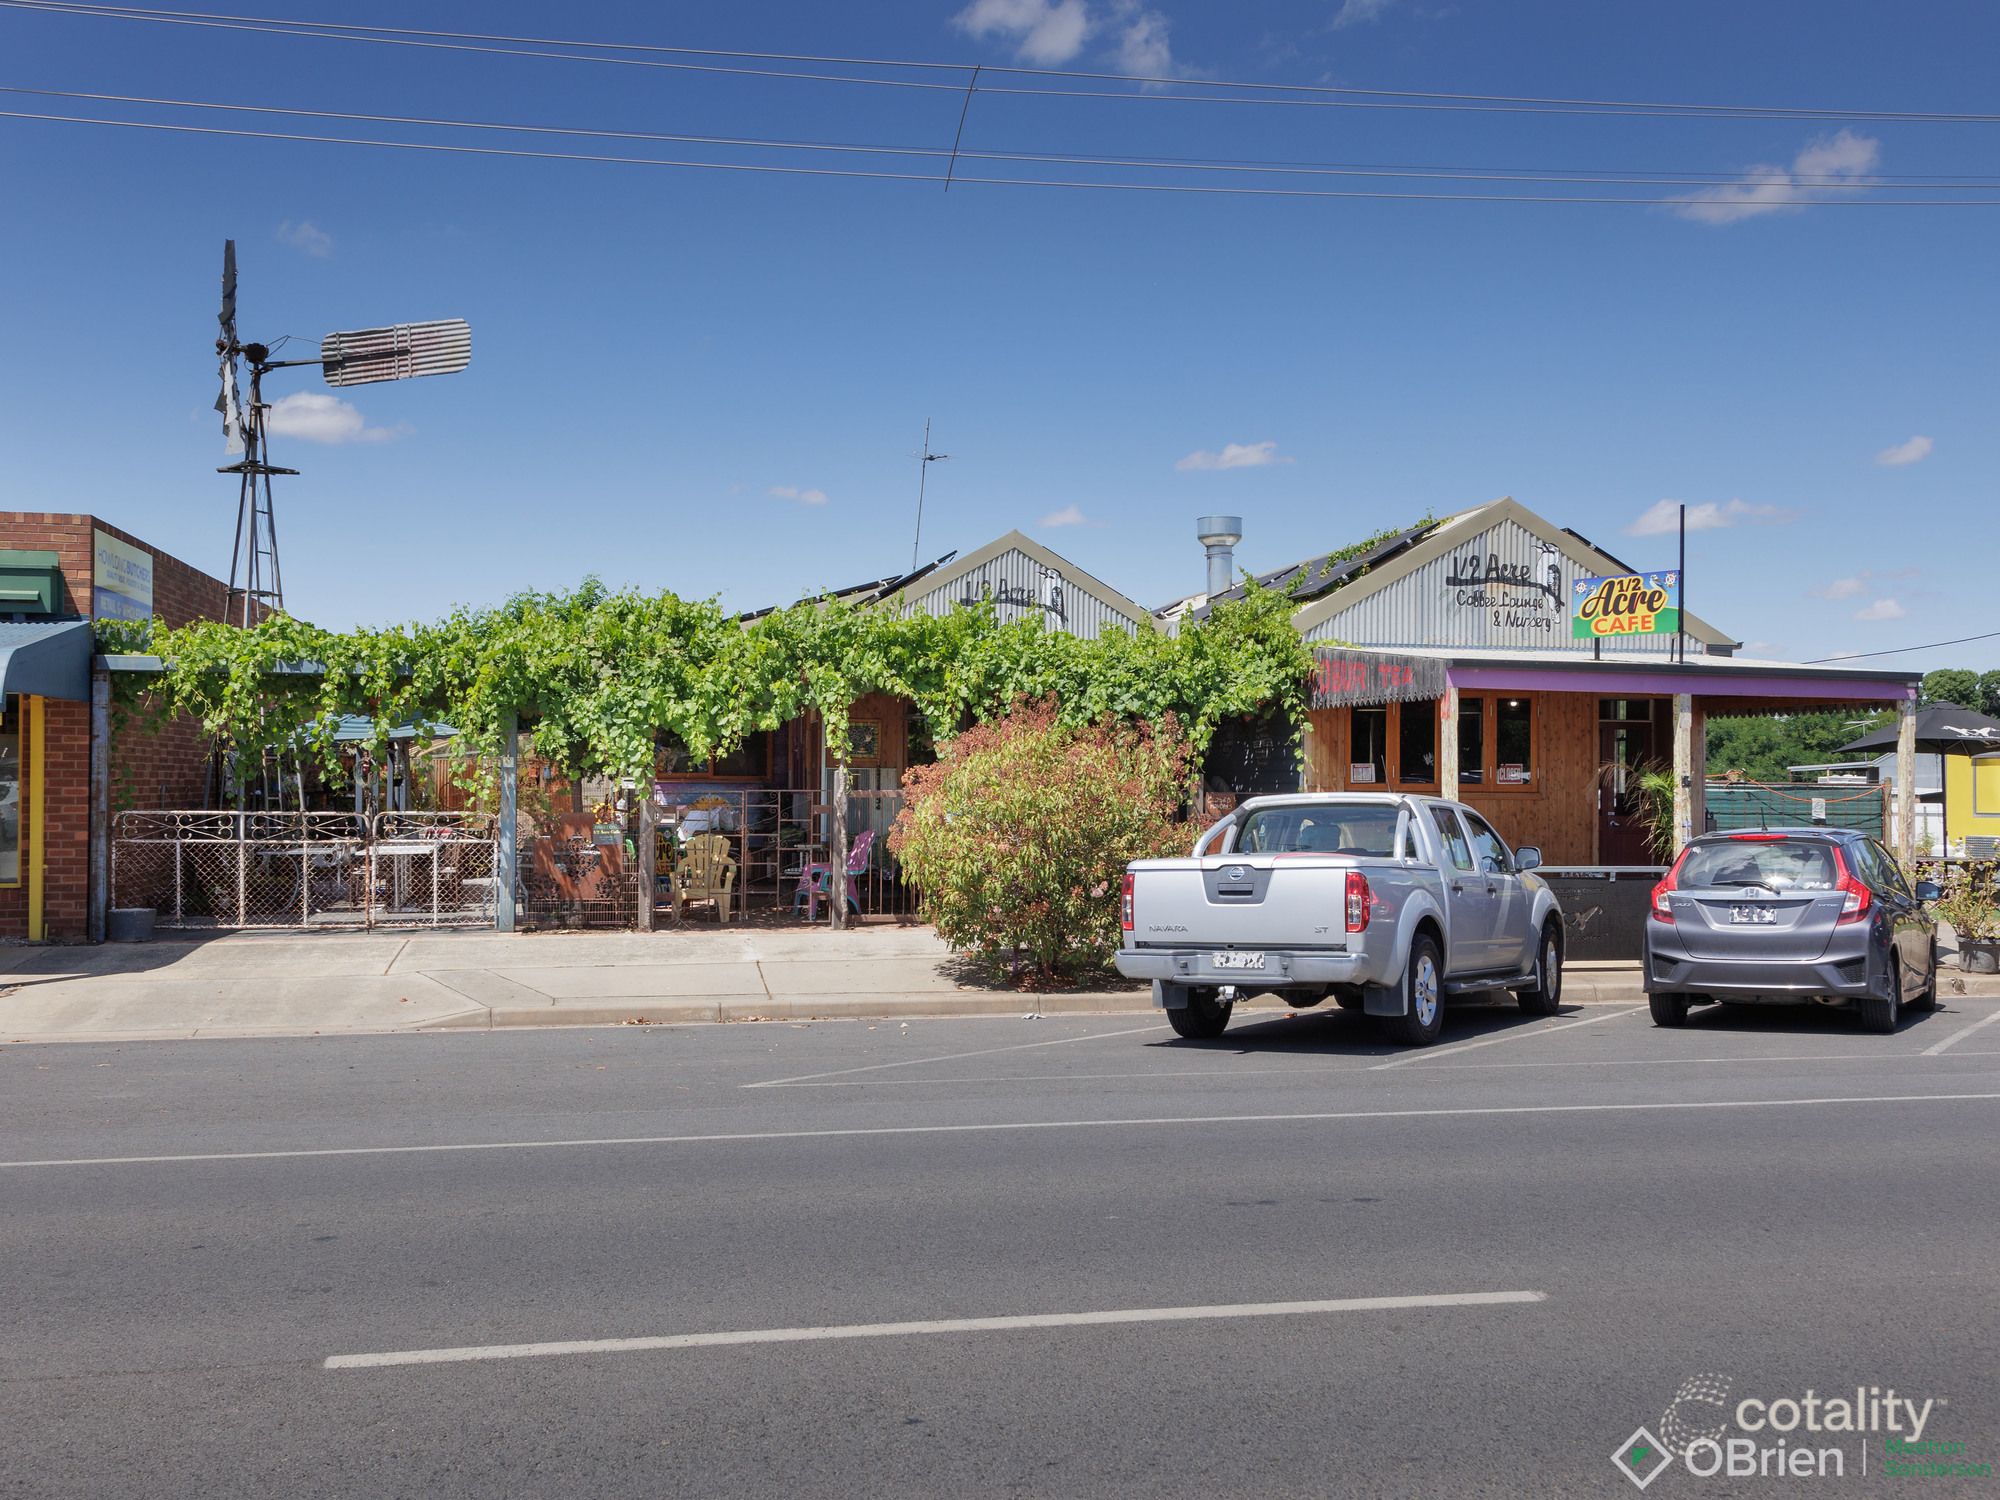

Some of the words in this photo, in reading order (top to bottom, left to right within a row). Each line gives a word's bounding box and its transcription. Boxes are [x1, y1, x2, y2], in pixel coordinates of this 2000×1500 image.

[1454, 555, 1480, 579] 1/2
[1486, 554, 1531, 580] Acre
[1617, 578, 1641, 592] 1/2
[1456, 590, 1497, 607] Coffee
[1499, 591, 1543, 611] Lounge
[1581, 580, 1667, 618] Acre
[1493, 610, 1501, 627] &
[1505, 610, 1551, 632] Nursery
[1593, 615, 1653, 633] CAFE
[1378, 663, 1413, 689] TEA
[1149, 925, 1189, 933] NAVARA
[1314, 926, 1329, 934] ST
